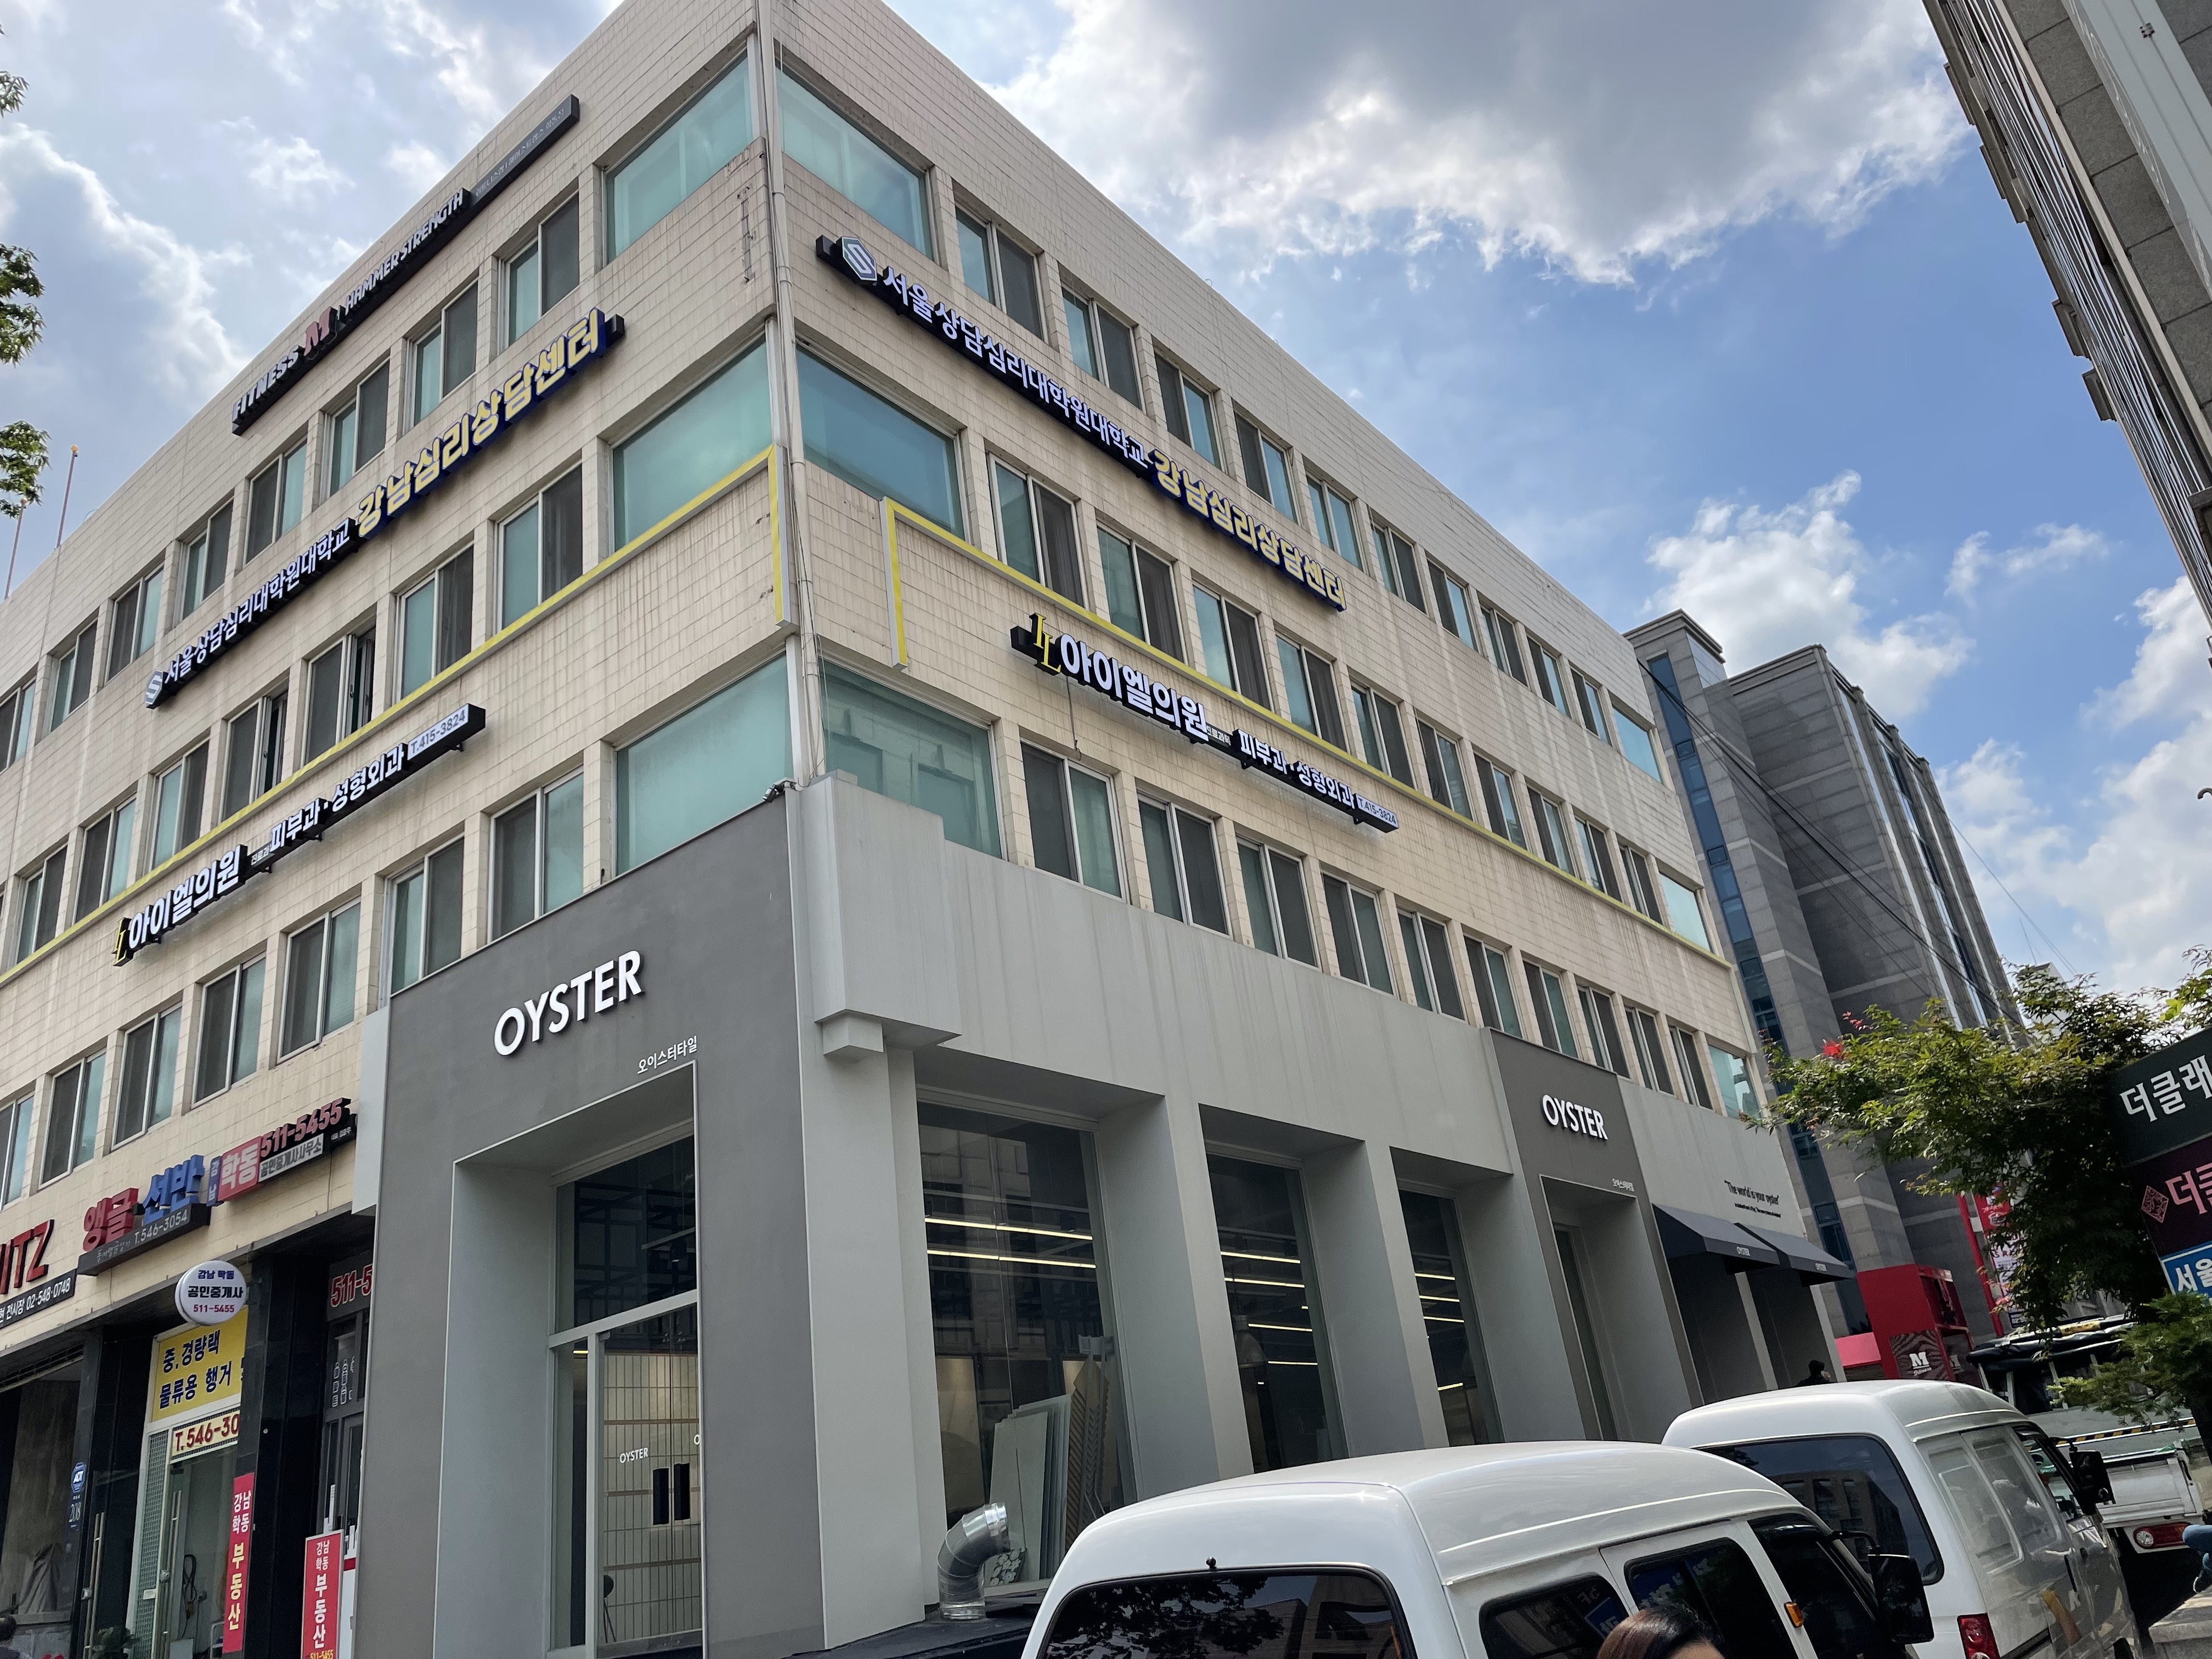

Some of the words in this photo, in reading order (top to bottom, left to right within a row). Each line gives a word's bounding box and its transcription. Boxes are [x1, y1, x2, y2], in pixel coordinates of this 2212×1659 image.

[232, 345, 300, 422] FITNESS
[345, 250, 400, 315] HAMMER
[399, 188, 465, 259] STRENGTH
[882, 267, 1148, 467] 서울상담심리대학원대학교
[1151, 449, 1346, 610] 강남심리상담센터
[165, 518, 350, 682] 서울상담심리대학원대학교
[358, 310, 600, 538] 강남심리상담센터
[1060, 633, 1209, 742] 아이엘의원
[1356, 795, 1397, 825] T.415-3824
[128, 844, 242, 950] 아이엘의원
[251, 843, 273, 866] 진료과
[411, 709, 466, 755] T.415-3824
[494, 950, 642, 1056] OYSTER
[637, 1036, 698, 1075] 오이스터타일
[1542, 1094, 1609, 1141] OYSTER
[221, 1143, 258, 1189] 학동
[261, 1098, 343, 1158] 511-5455
[260, 1140, 323, 1178] 공인중개사사무소
[134, 1209, 188, 1246] T.546-3054
[0, 1220, 54, 1294] ITZ
[198, 1269, 216, 1279] 강남
[188, 1285, 244, 1298] 공인중개사
[194, 1304, 235, 1313] 511-5455
[160, 1374, 198, 1409] 물류용
[206, 1361, 233, 1393] 행거
[619, 1447, 649, 1464] OYSTER
[232, 1513, 250, 1534] 학동
[234, 1490, 252, 1513] 강남
[316, 1539, 330, 1556] 강남
[228, 1542, 244, 1631] 부동산
[312, 1572, 328, 1649] 부동산
